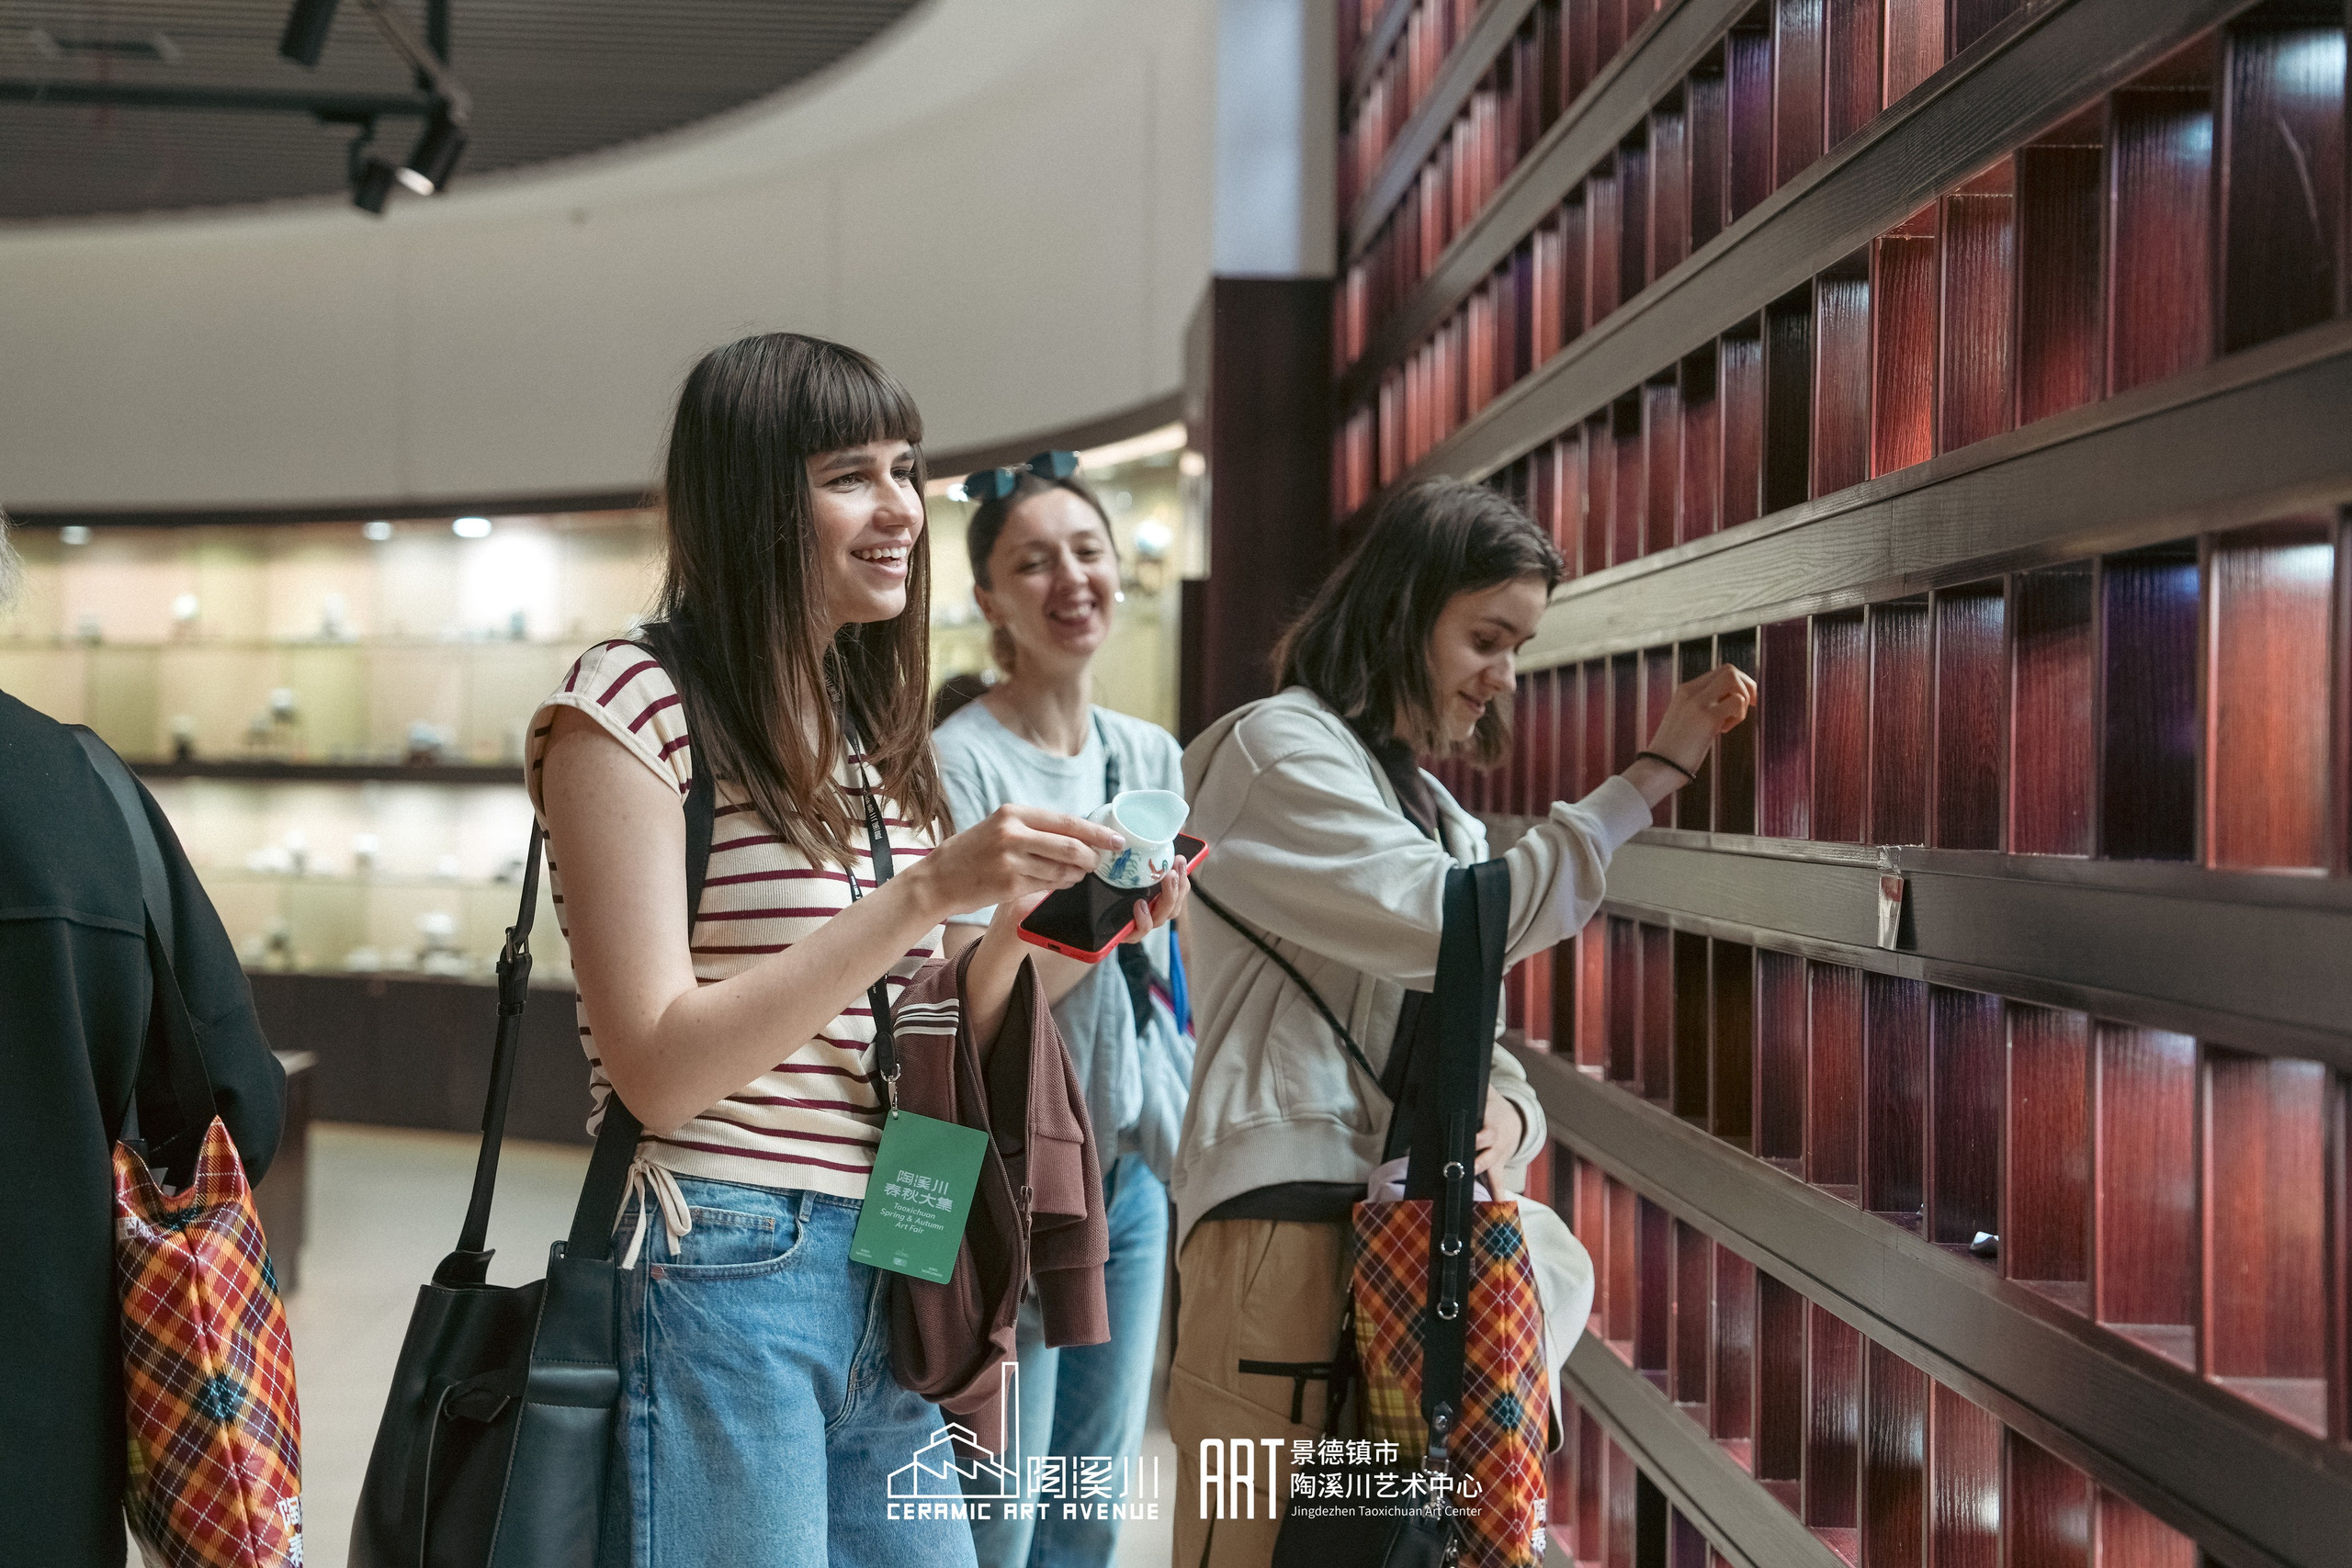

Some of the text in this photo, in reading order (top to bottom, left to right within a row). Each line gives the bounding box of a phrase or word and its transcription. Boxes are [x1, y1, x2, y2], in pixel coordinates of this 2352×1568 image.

[897, 1170, 949, 1195] 陶溪川
[884, 1183, 953, 1213] 春秋大集
[880, 1208, 905, 1222] Spring
[914, 1218, 944, 1231] Autumn
[894, 1202, 936, 1219] Taoxichuan
[895, 1222, 924, 1234] Art Fair
